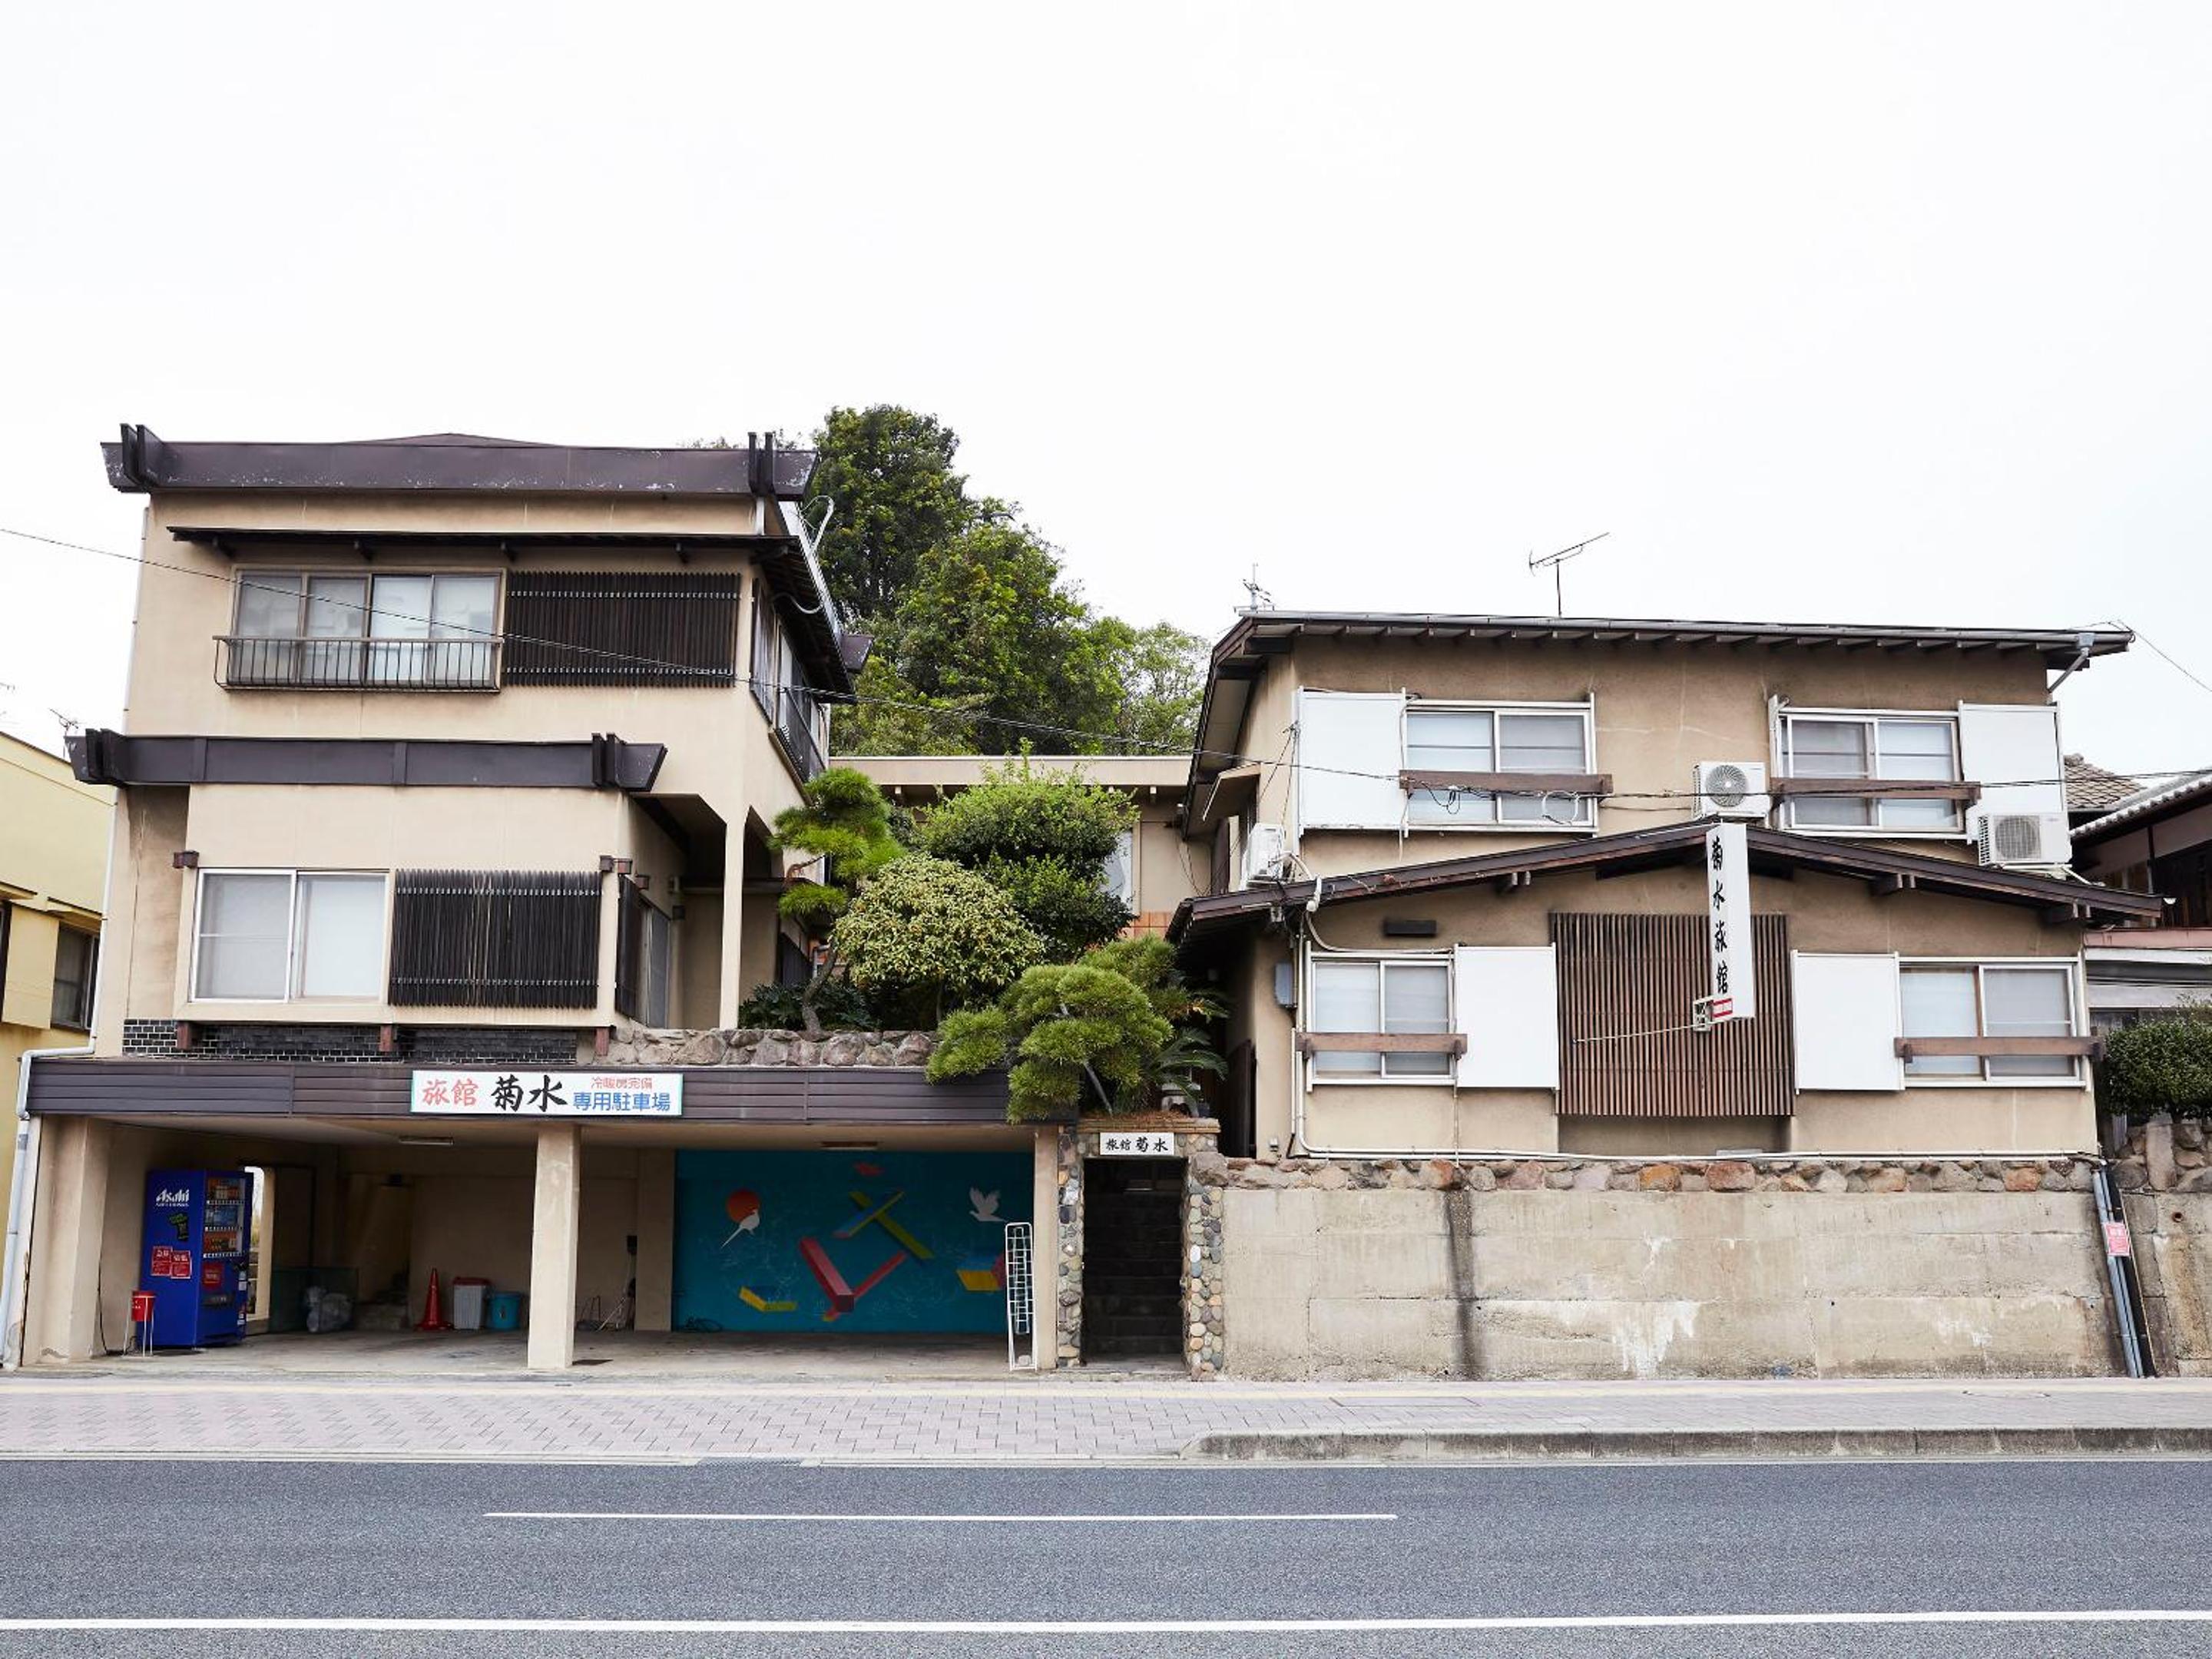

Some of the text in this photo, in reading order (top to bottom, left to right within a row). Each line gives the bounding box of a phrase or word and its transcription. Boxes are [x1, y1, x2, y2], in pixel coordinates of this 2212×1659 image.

[422, 1074, 568, 1112] 旅館 菊水
[573, 1091, 671, 1111] 専用駐車場
[156, 1188, 190, 1202] Asahi
